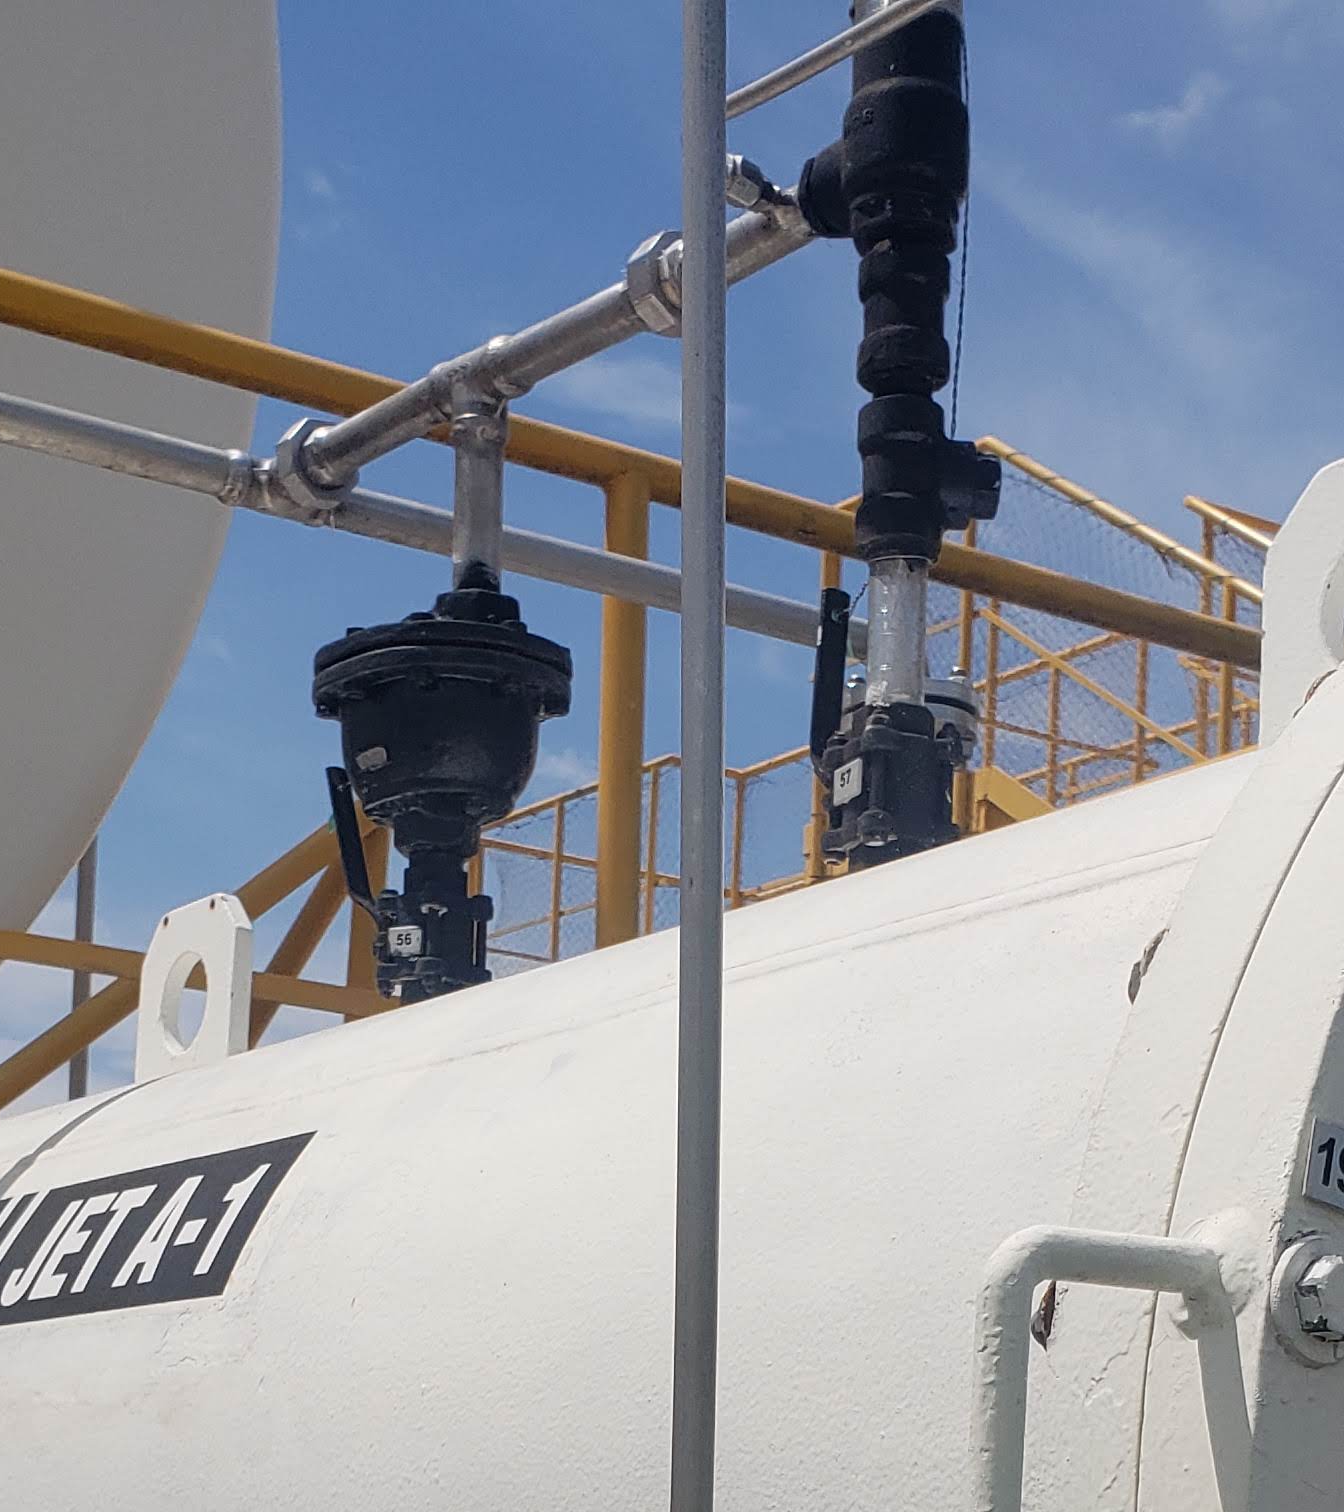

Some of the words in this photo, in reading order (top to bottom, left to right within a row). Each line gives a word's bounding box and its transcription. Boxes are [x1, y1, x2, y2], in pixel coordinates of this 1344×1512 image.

[838, 768, 854, 788] 57
[395, 932, 412, 947] 56
[0, 1184, 158, 1308] JET
[111, 1163, 272, 1289] A-1
